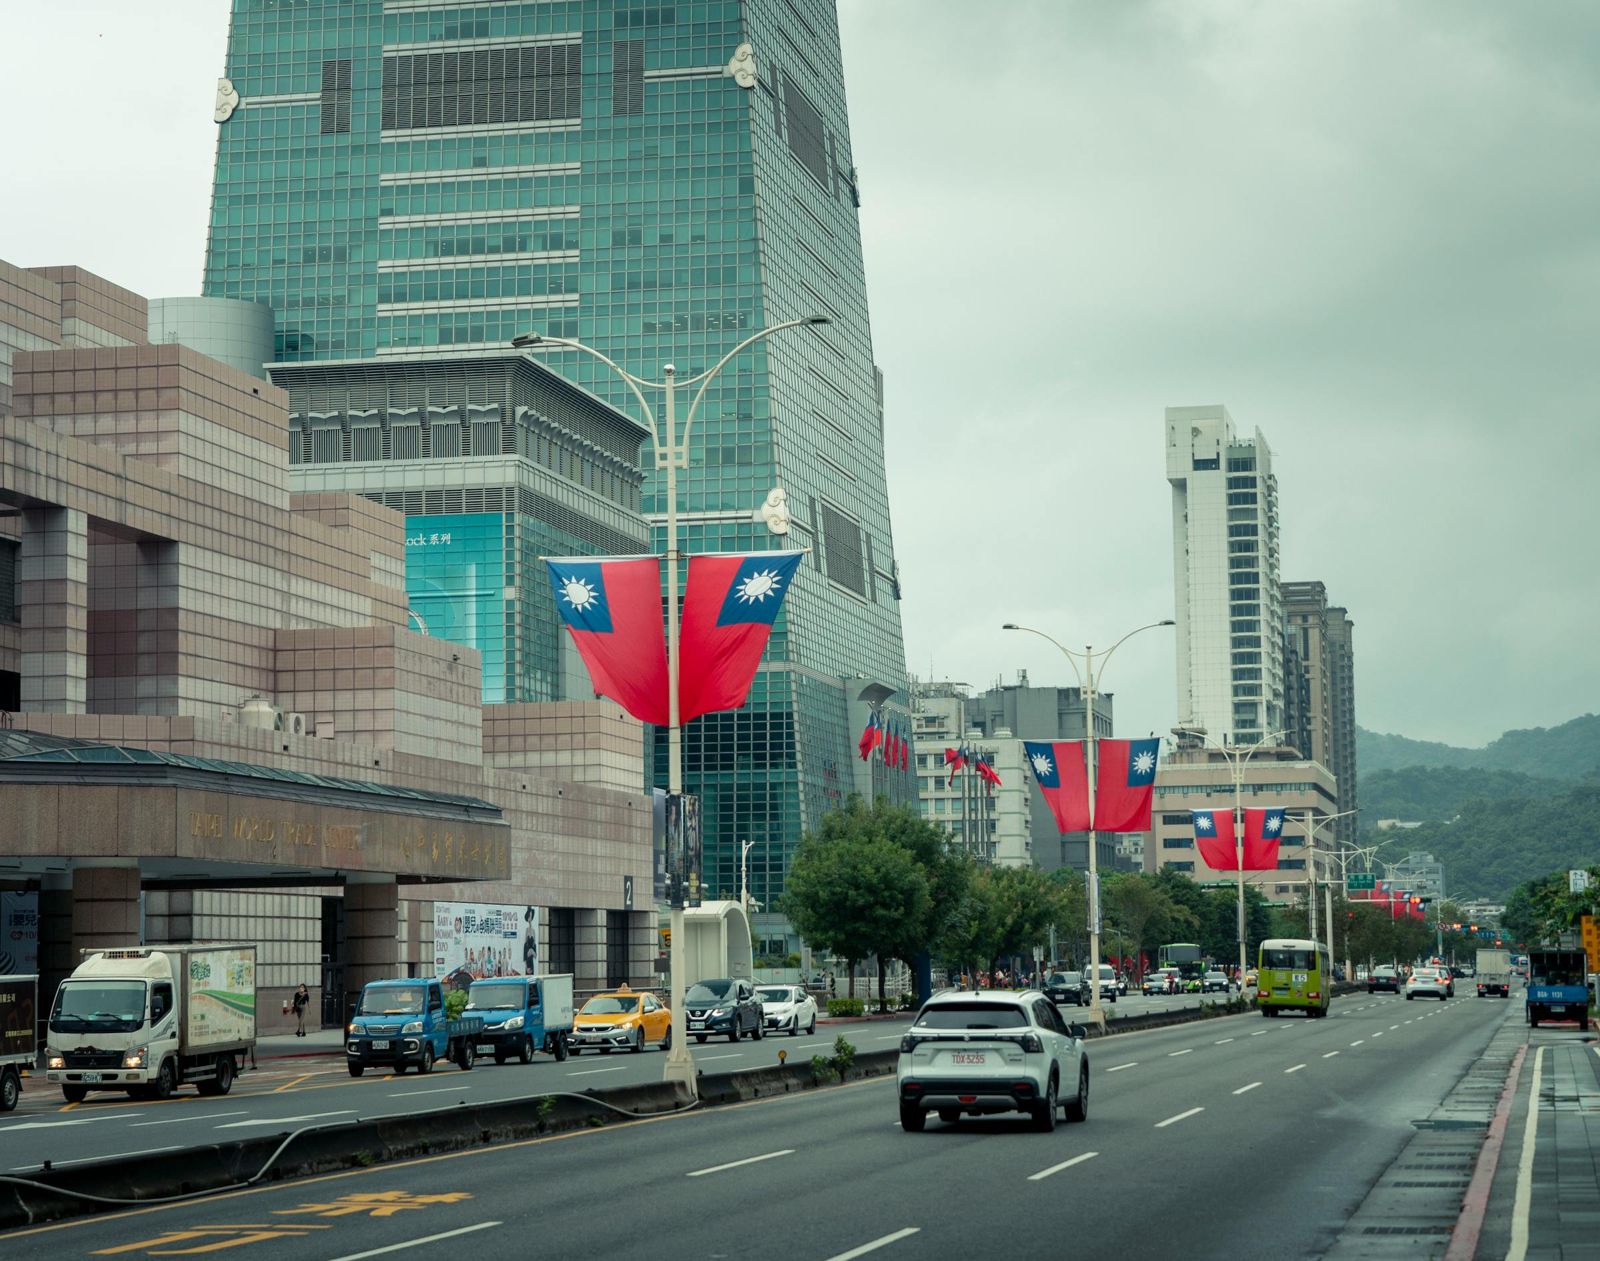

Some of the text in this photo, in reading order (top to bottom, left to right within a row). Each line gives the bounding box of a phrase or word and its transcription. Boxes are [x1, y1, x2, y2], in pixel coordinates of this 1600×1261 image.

[405, 533, 451, 546] ock 系列
[190, 811, 223, 839] TAIPEI
[233, 815, 275, 843] WORLD
[281, 819, 318, 847] TRADE
[626, 881, 631, 905] 2
